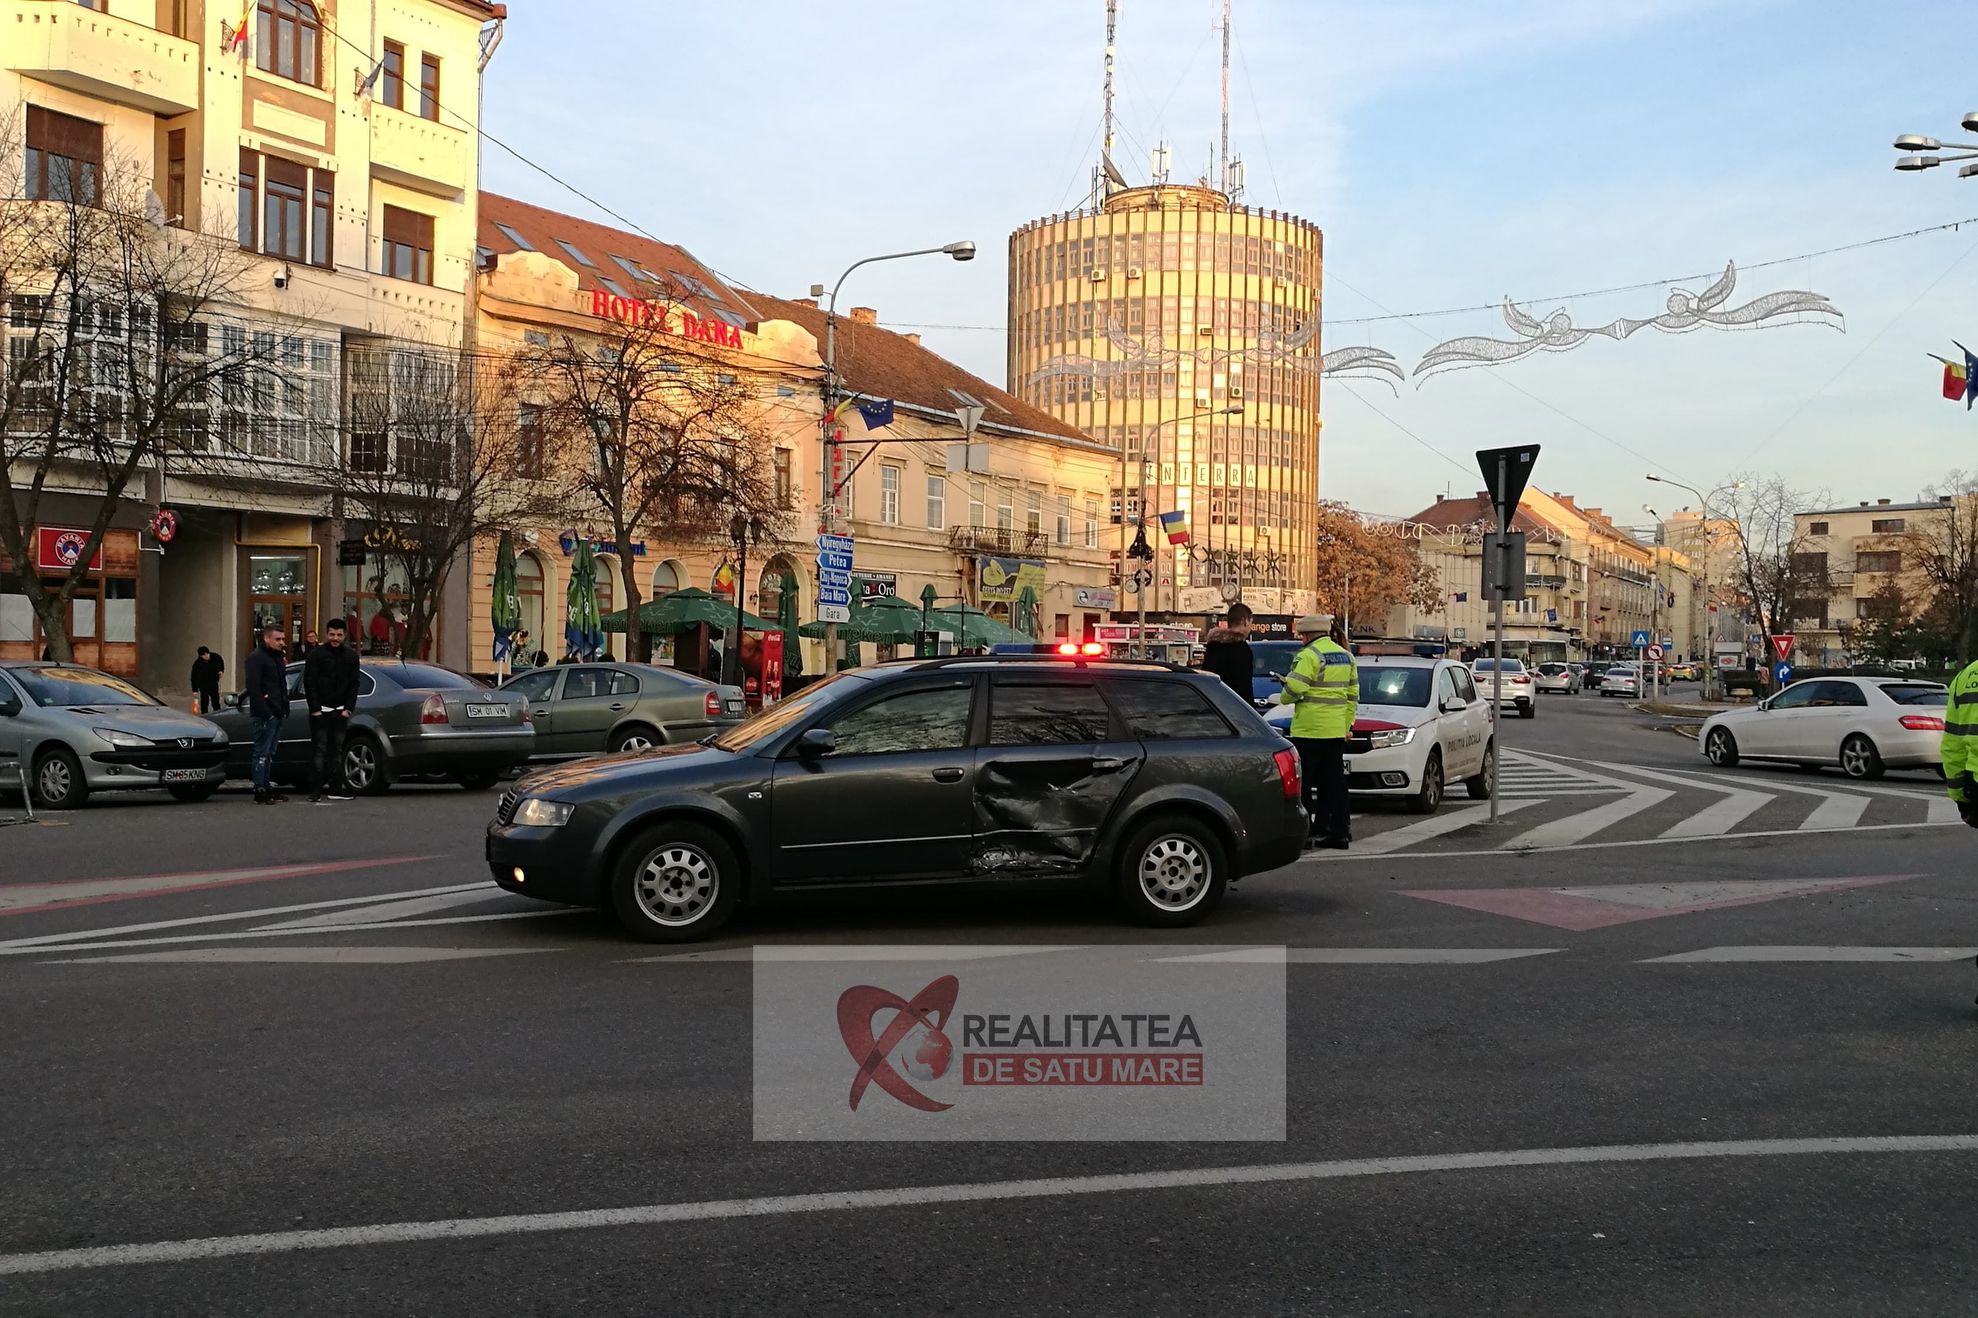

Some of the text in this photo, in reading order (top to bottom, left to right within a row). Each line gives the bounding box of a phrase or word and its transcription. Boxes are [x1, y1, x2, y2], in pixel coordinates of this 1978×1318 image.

[592, 288, 744, 350] HOTEL DANA
[57, 533, 86, 549] BAVARIA
[829, 554, 847, 567] Petea
[820, 570, 847, 586] Cluj-Napoca
[820, 588, 846, 601] Baia Mare
[825, 607, 840, 619] Gara
[1251, 622, 1287, 633] ange store
